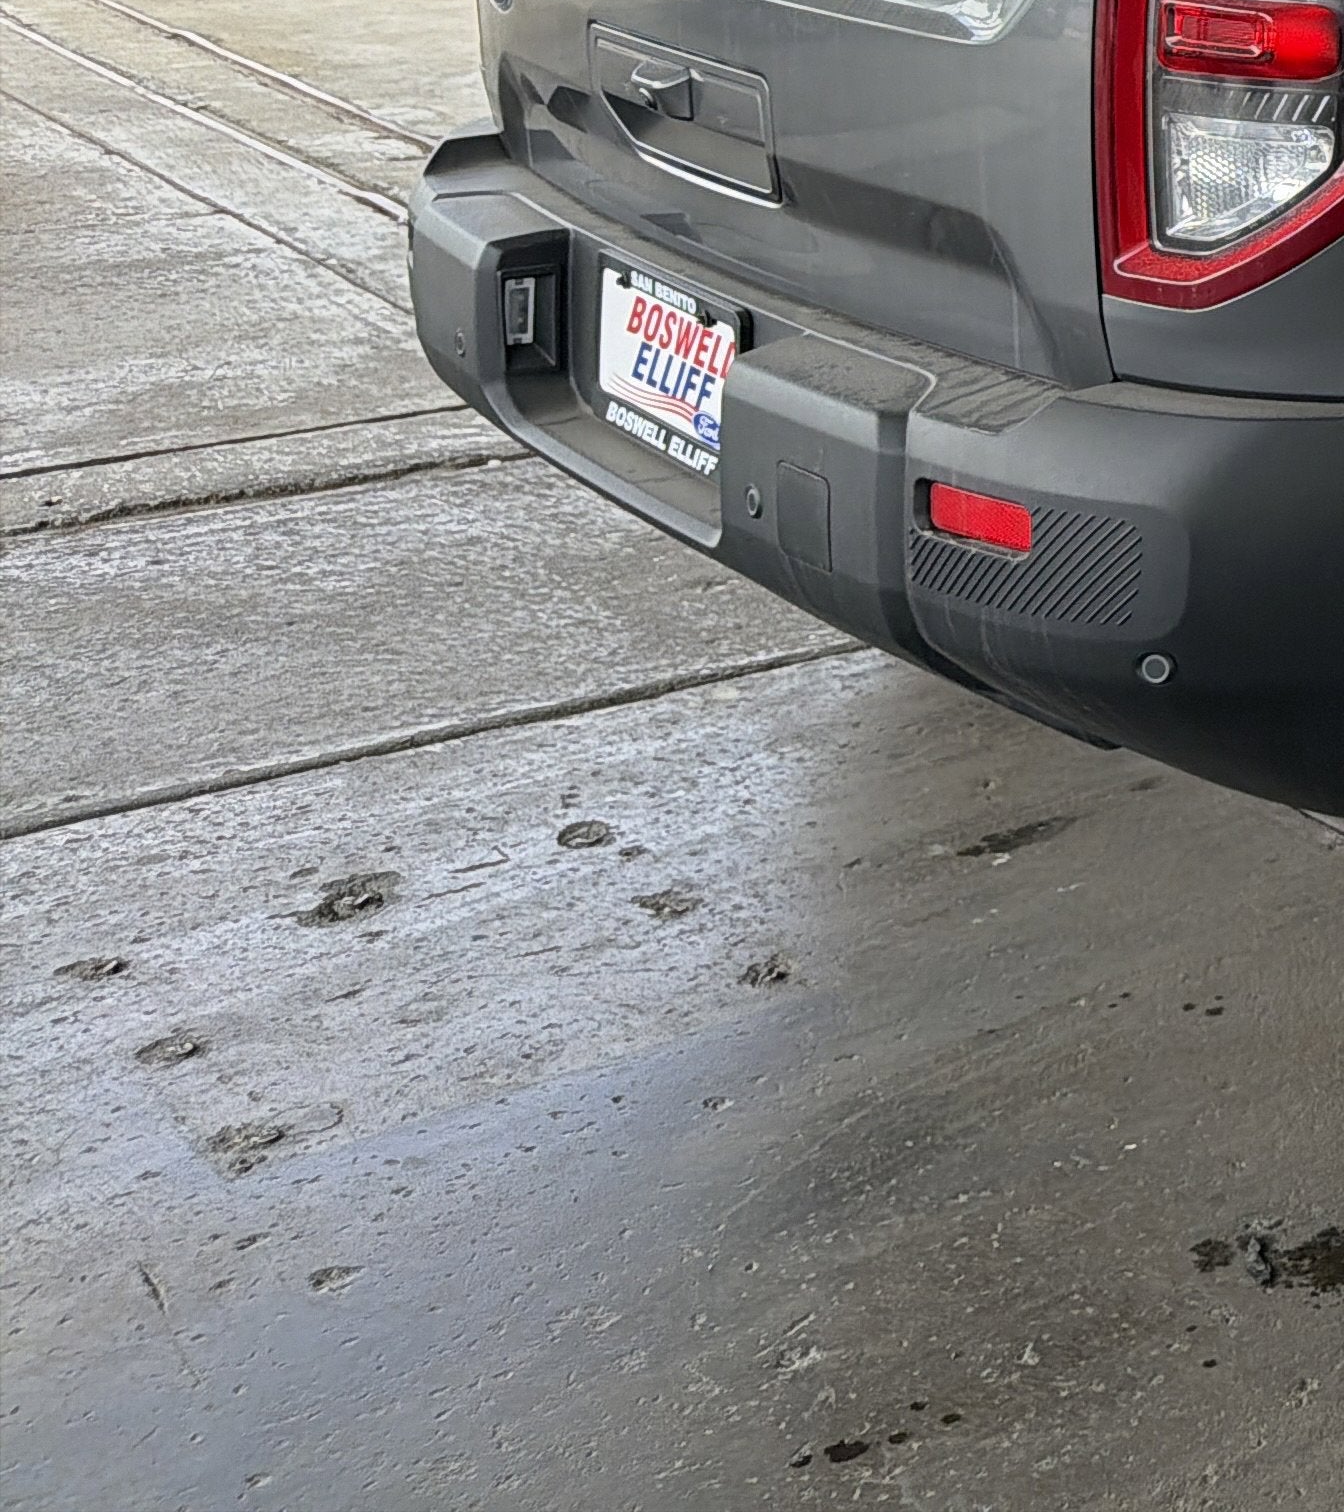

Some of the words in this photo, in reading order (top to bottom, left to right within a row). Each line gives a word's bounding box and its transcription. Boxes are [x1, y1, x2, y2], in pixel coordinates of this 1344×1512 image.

[630, 270, 653, 295] SAN
[654, 282, 697, 314] BENITO
[631, 341, 717, 412] ELLIFF
[605, 400, 667, 451] BOSWELL
[667, 434, 719, 476] ELLIFF
